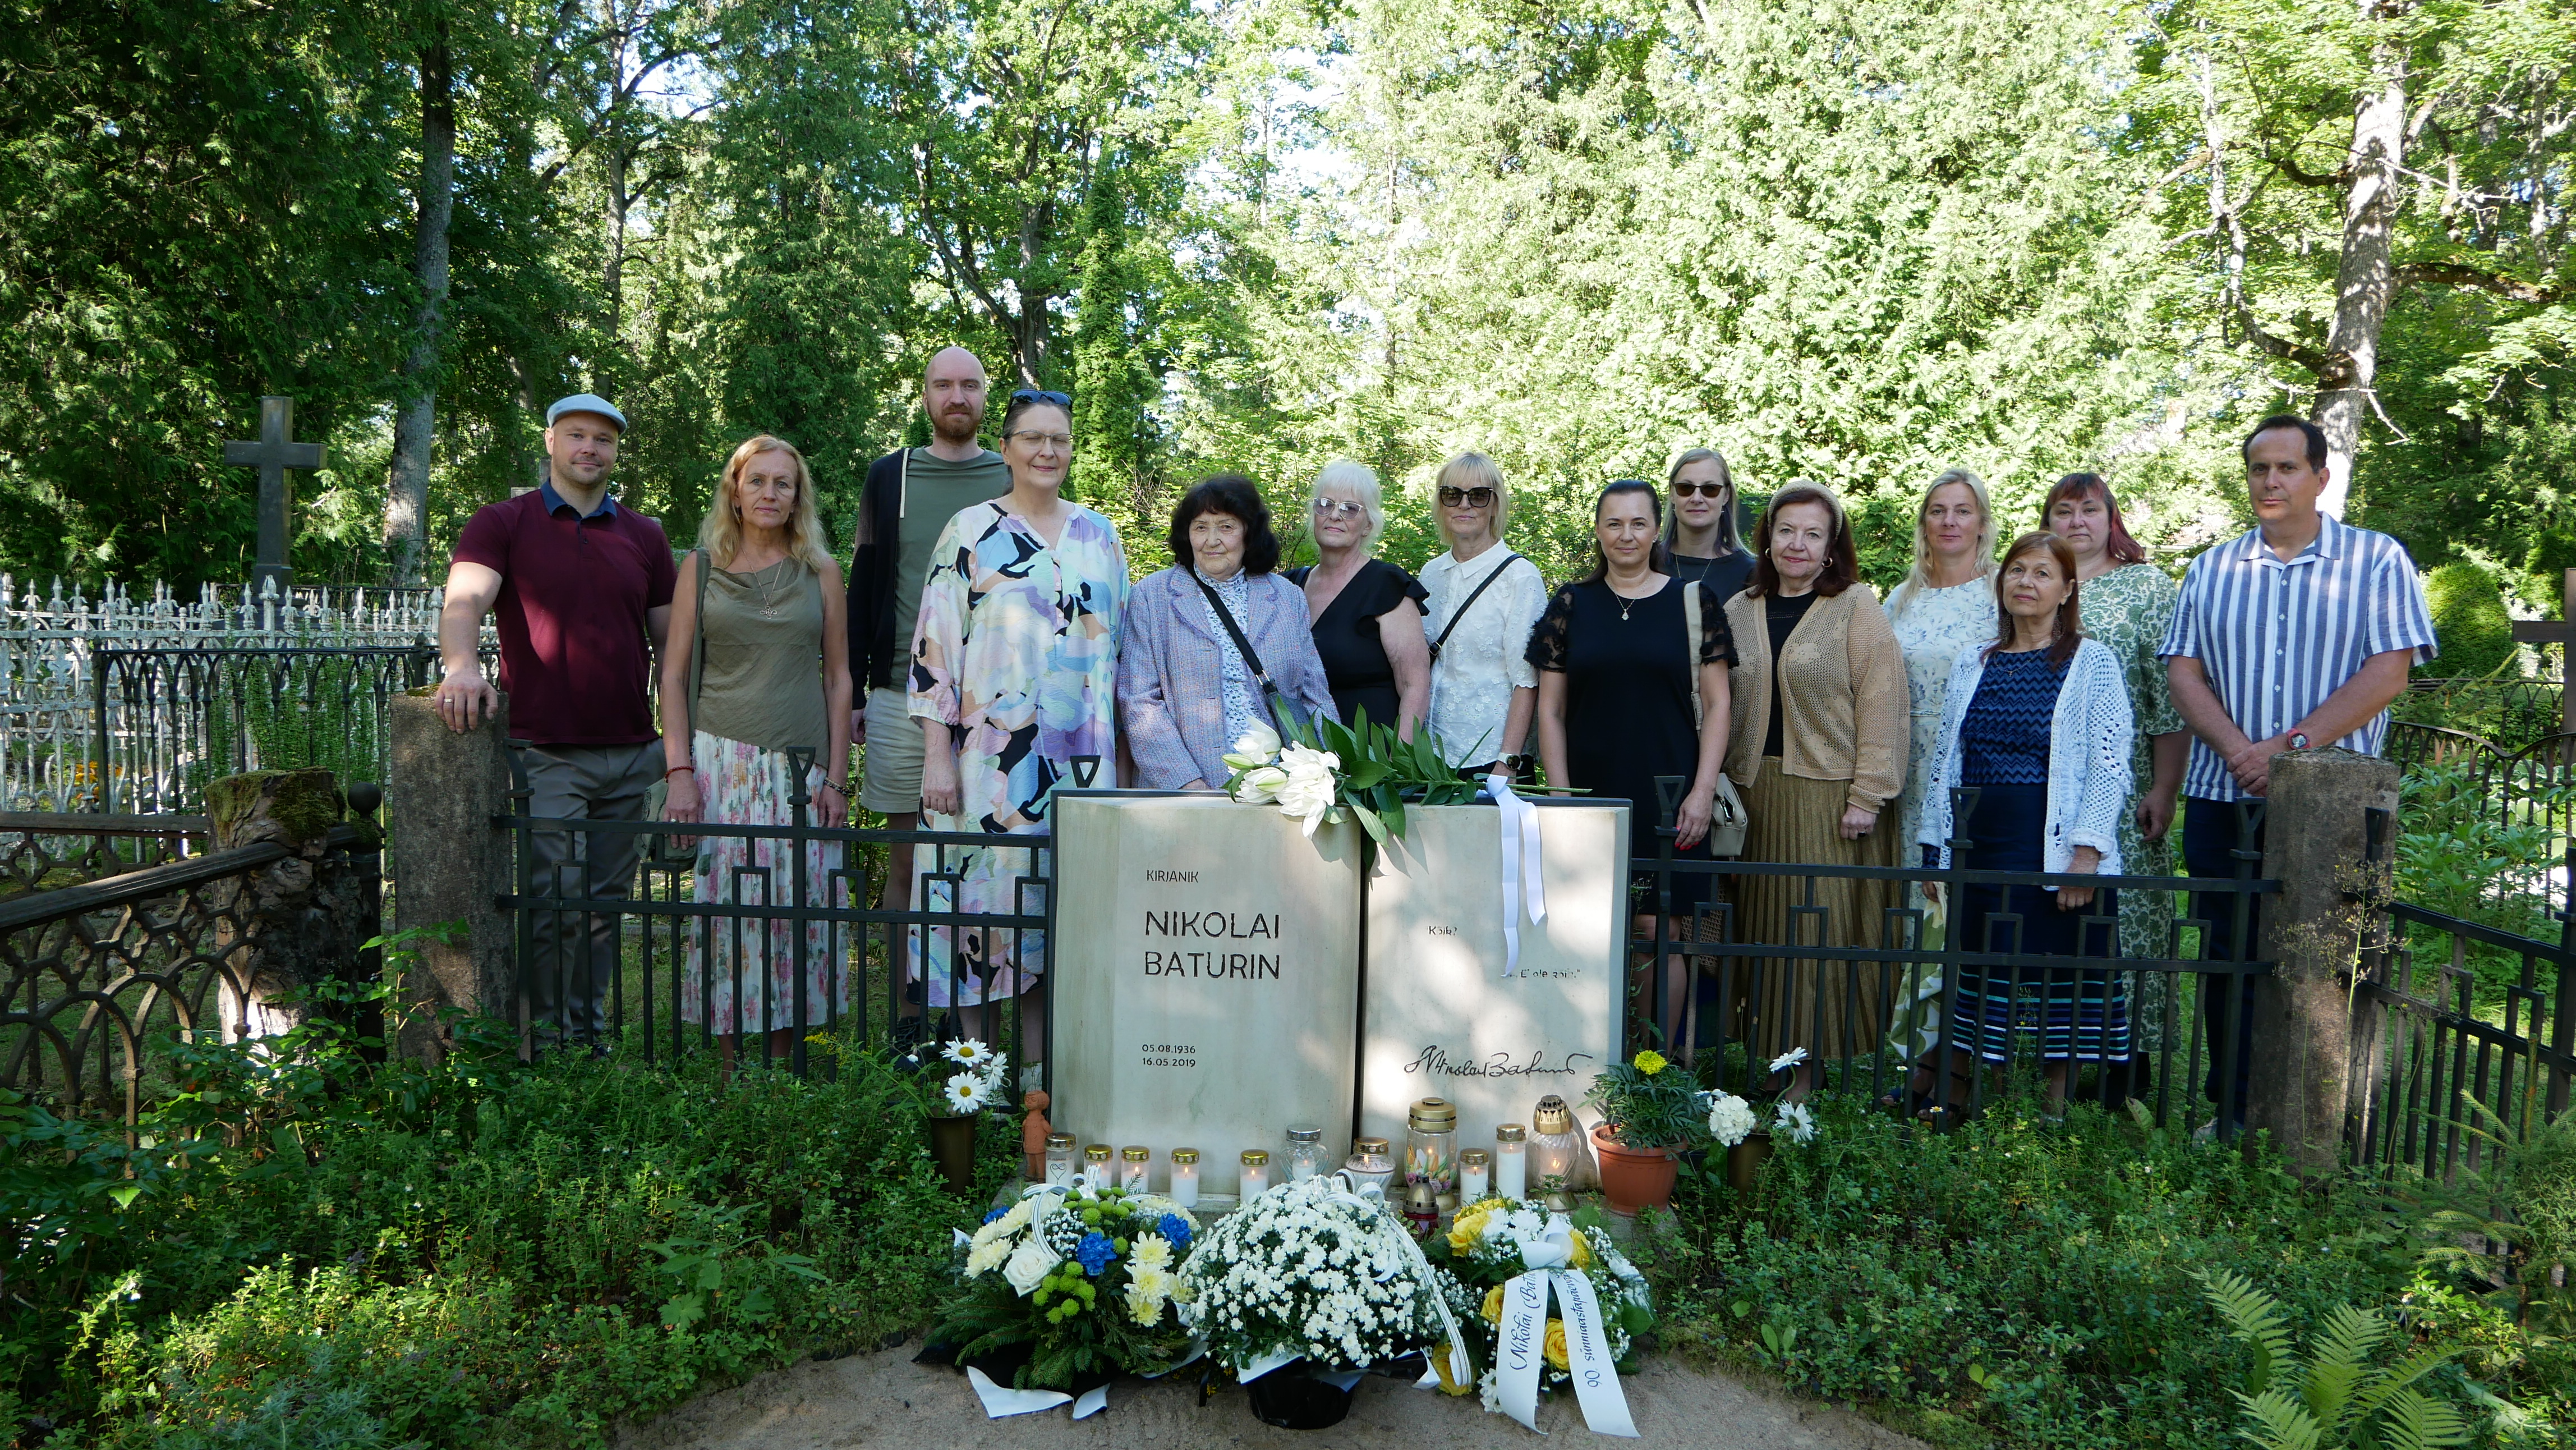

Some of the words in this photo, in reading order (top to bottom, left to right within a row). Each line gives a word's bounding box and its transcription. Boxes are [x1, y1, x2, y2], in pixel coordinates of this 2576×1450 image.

[1146, 869, 1199, 883] KIRJANIK
[1145, 911, 1280, 939] NIKOLAI
[1145, 952, 1280, 979] BATURIN
[1142, 1044, 1195, 1054] 05.08.1936
[1143, 1057, 1195, 1067] 16.05.2019
[1509, 1311, 1533, 1370] Nikolai
